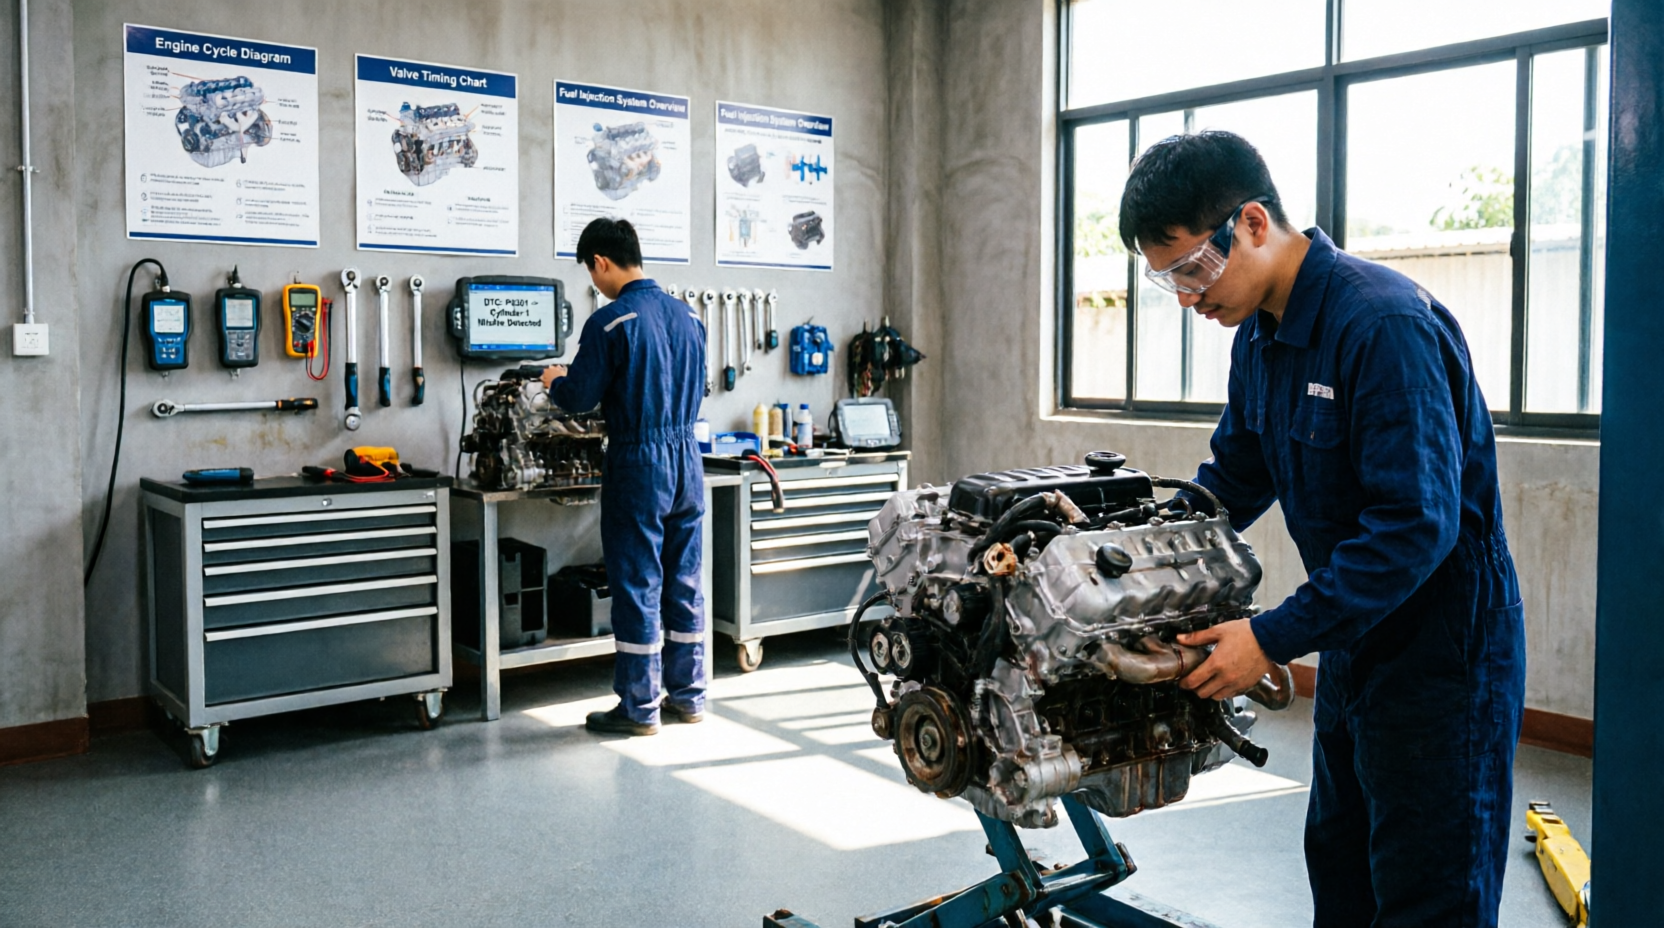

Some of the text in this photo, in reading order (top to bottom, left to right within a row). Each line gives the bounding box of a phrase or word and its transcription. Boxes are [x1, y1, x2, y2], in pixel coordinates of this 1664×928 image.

[155, 37, 291, 64] Engine Cycle Diagram
[389, 66, 487, 88] Valve Timing Chart
